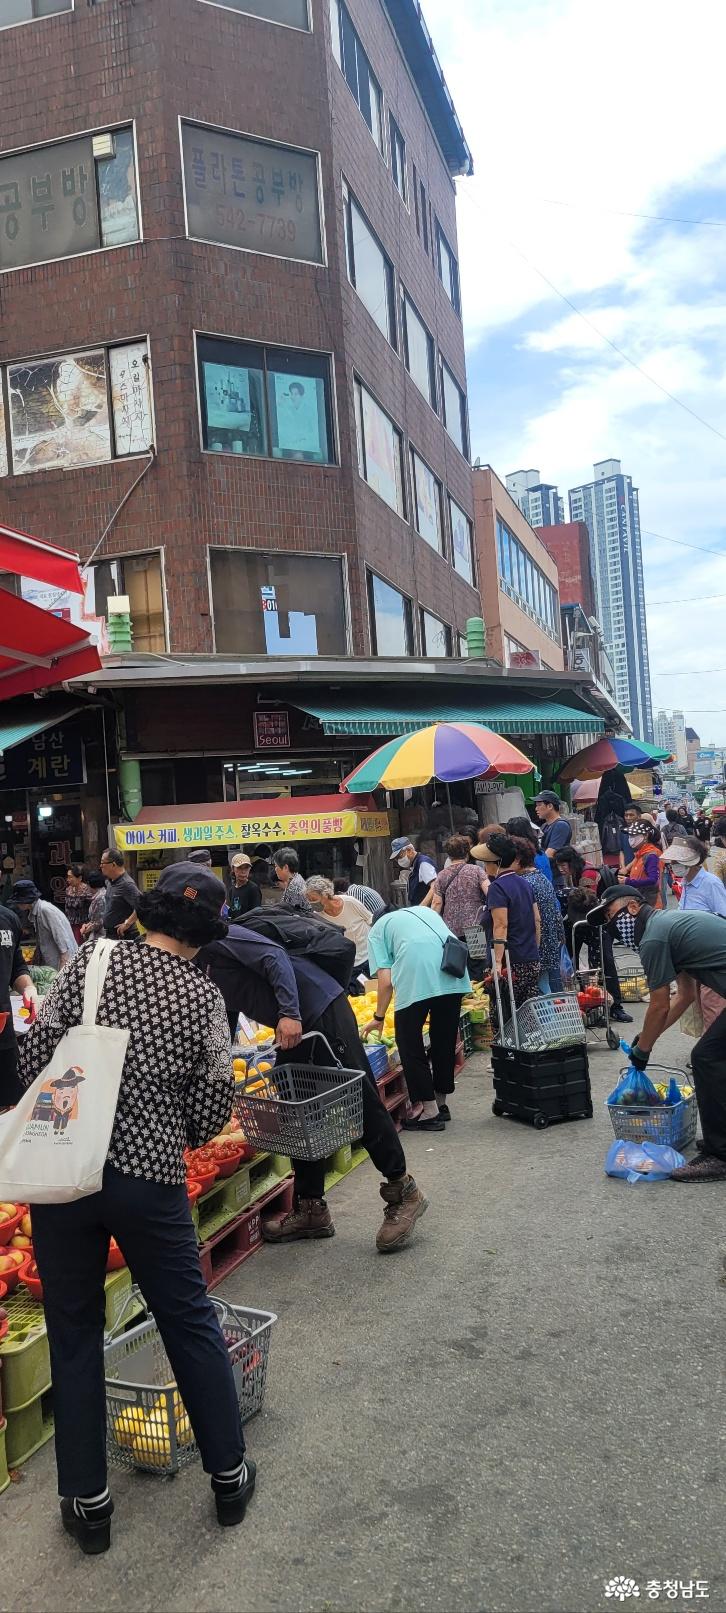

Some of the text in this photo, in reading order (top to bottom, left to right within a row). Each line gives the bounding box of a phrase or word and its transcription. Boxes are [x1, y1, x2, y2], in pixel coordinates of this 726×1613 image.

[192, 146, 304, 214] 플라톤공부방
[216, 203, 296, 241] 542-7739
[621, 504, 629, 553] CANTAVIL
[260, 734, 287, 745] Seoul
[28, 754, 71, 779] 계란
[288, 817, 343, 836] 추억의풀빵
